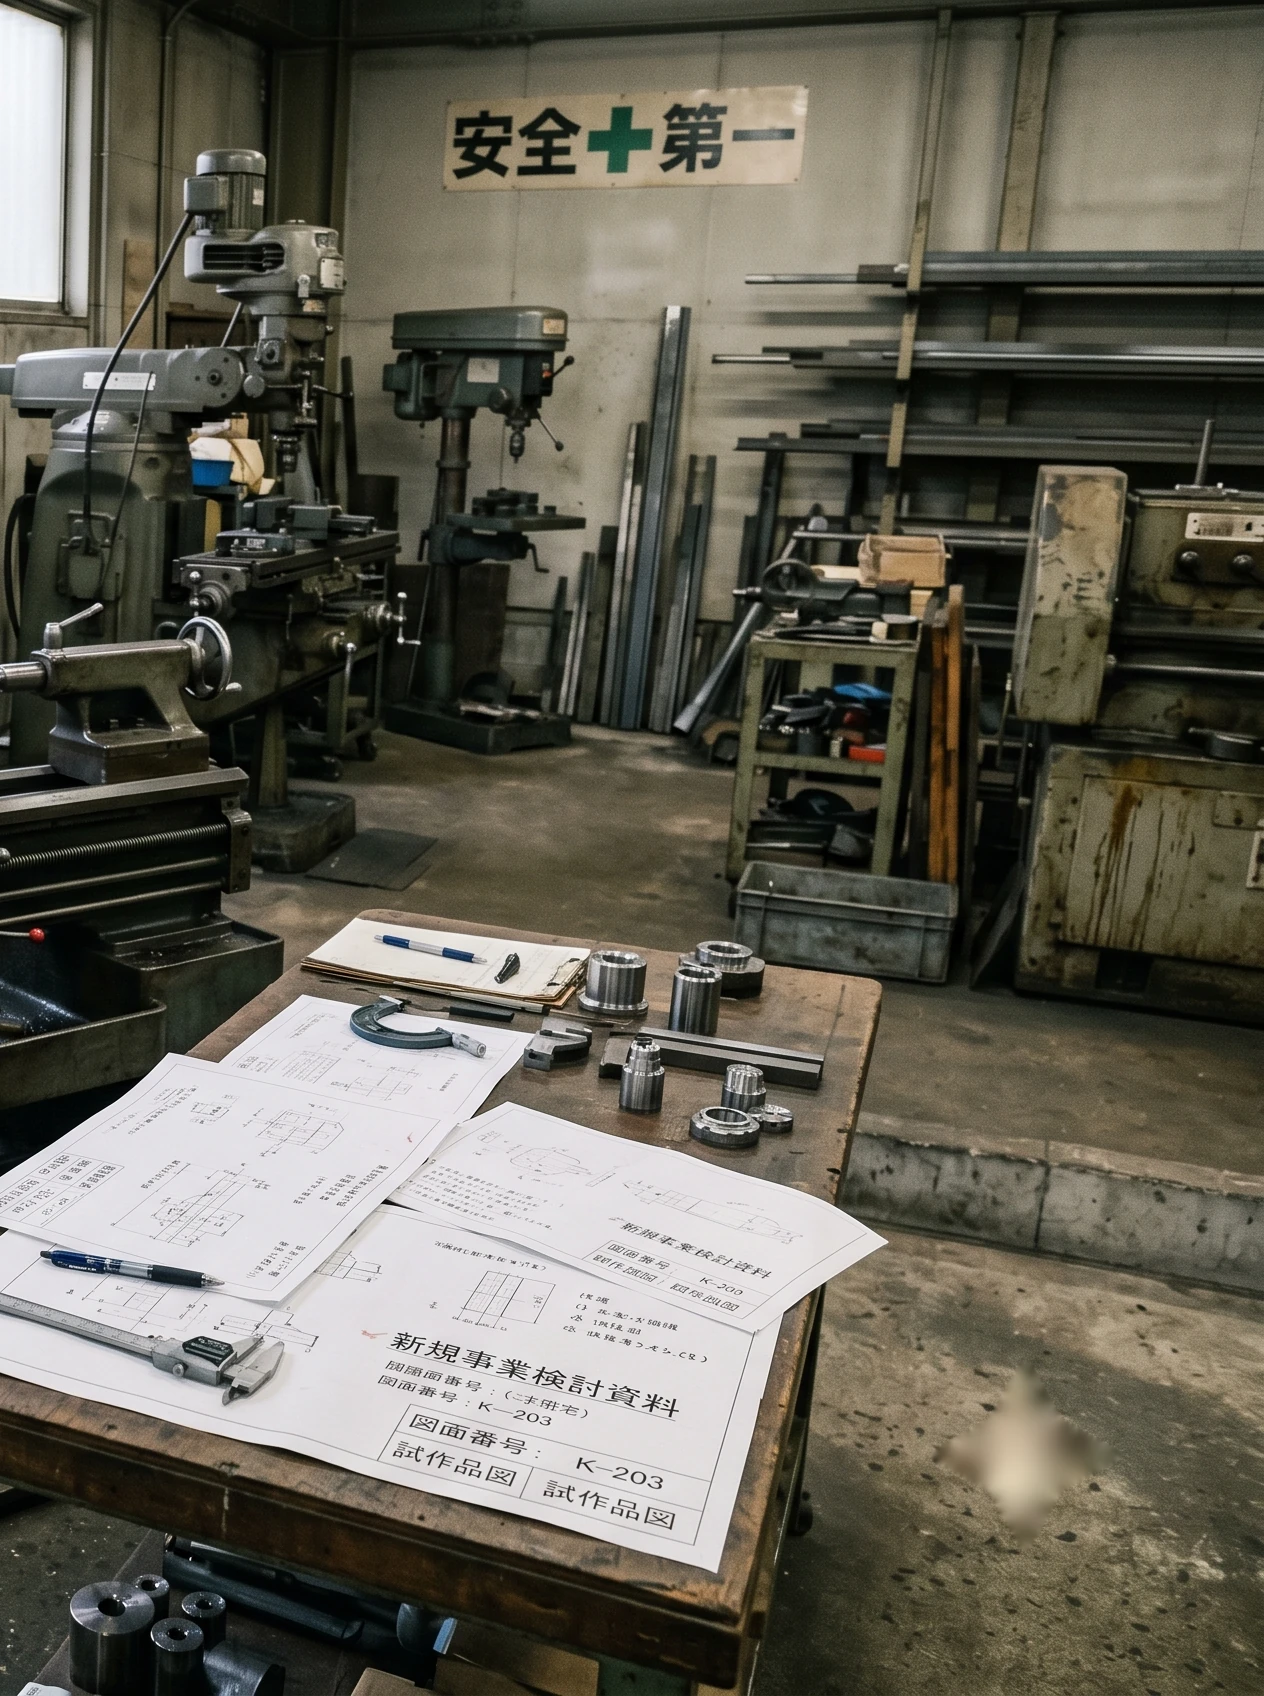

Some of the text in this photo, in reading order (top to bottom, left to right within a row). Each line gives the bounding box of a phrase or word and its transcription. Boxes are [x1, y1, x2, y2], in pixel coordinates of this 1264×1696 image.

[390, 1331, 680, 1419] 新規事業検討資料
[393, 1440, 676, 1531] 試作品図 試作品図
[575, 1456, 664, 1491] K-203
